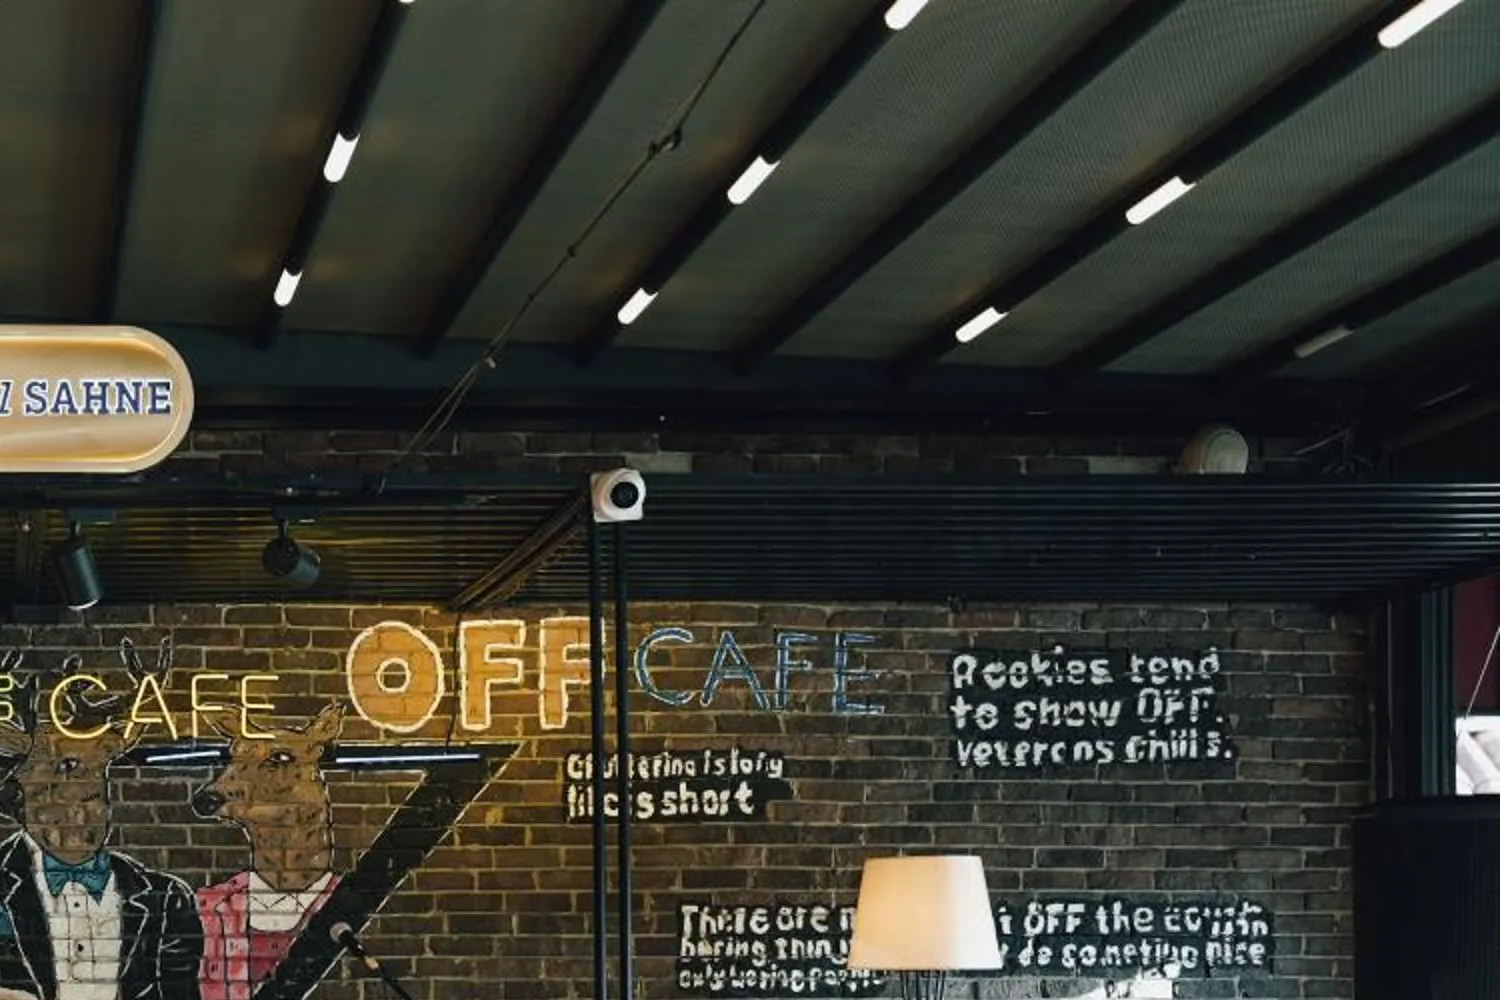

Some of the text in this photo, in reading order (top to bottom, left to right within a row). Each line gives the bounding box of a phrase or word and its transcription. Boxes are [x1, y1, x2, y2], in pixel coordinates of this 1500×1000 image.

[24, 378, 173, 416] SAHNE
[346, 617, 886, 733] OFF CAFE
[1130, 646, 1221, 686] tend
[50, 673, 280, 742] CAFE
[950, 694, 1000, 731] to
[1013, 696, 1123, 731] show
[660, 780, 755, 817] short
[680, 904, 771, 938] There
[776, 905, 830, 934] are
[1023, 901, 1085, 936] OFF
[1095, 900, 1154, 934] the
